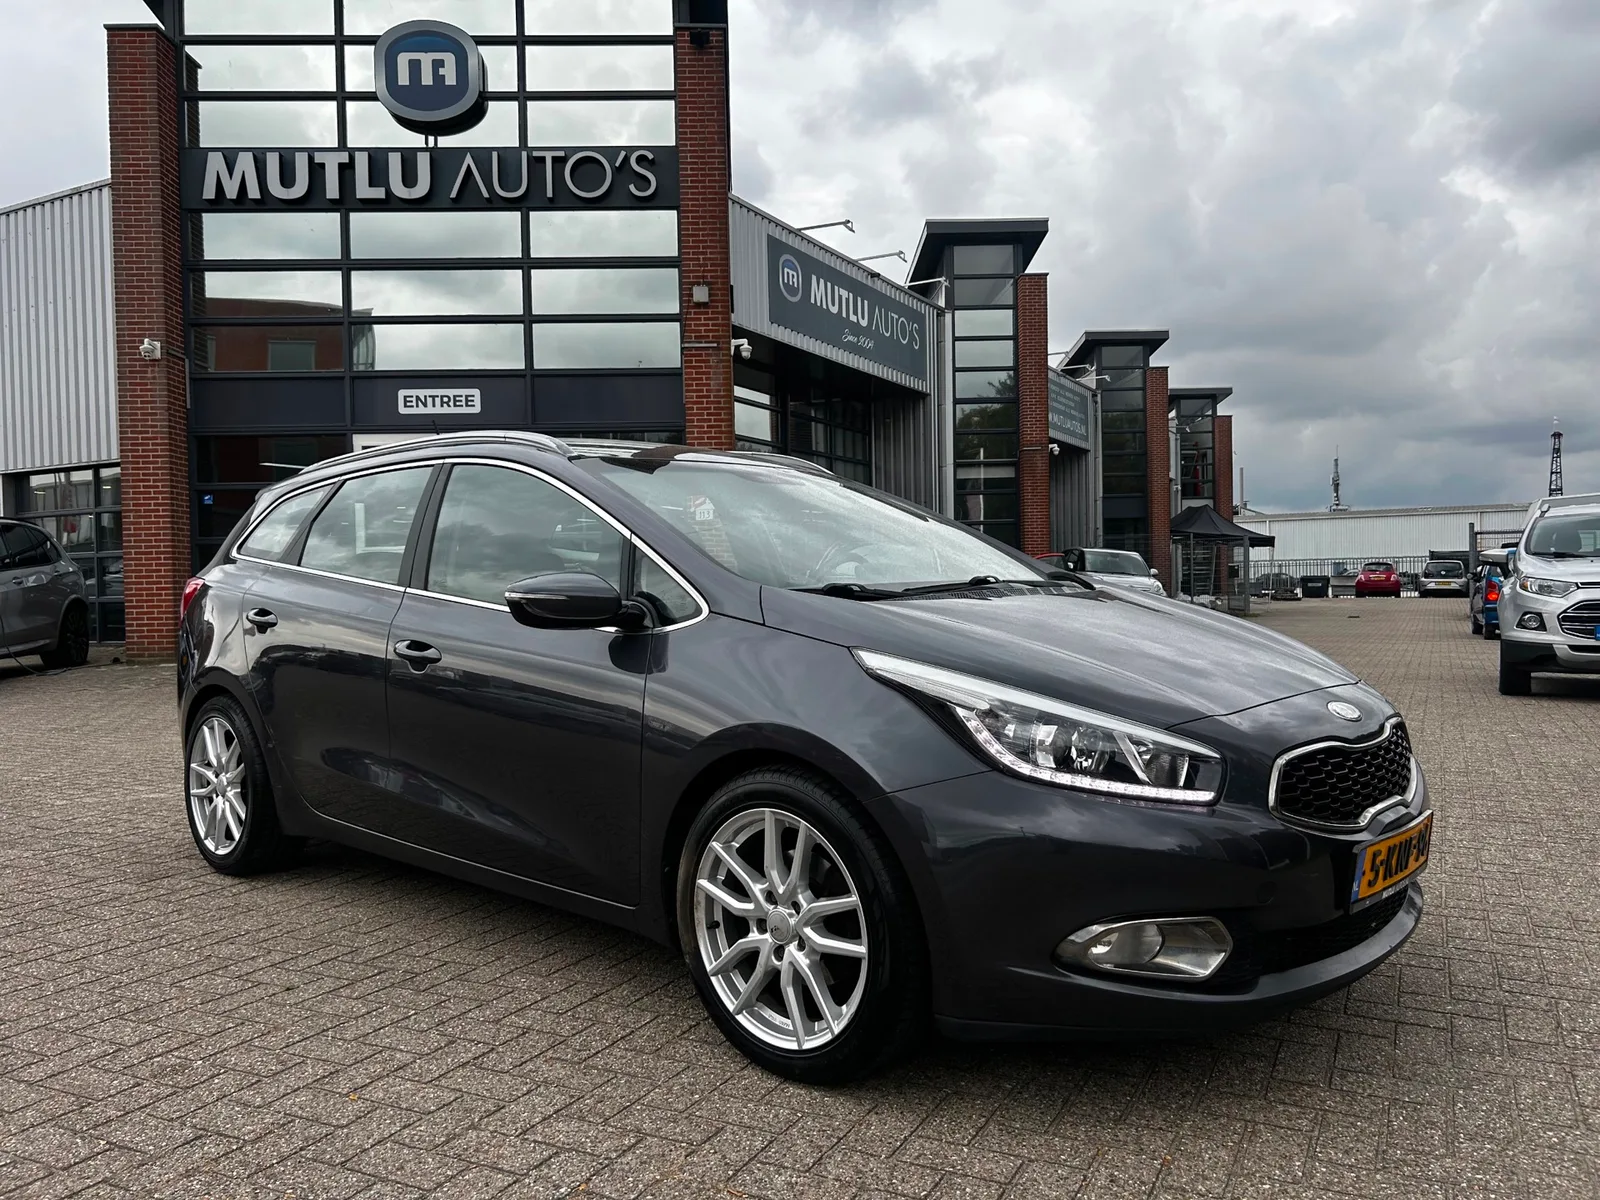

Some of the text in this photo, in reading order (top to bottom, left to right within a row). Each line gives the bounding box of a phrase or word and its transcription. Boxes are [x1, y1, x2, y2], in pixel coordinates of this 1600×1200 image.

[202, 150, 658, 200] MUTLU AUTO'S
[810, 274, 920, 350] MUTLU AUTO'S
[402, 394, 476, 409] ENTREE
